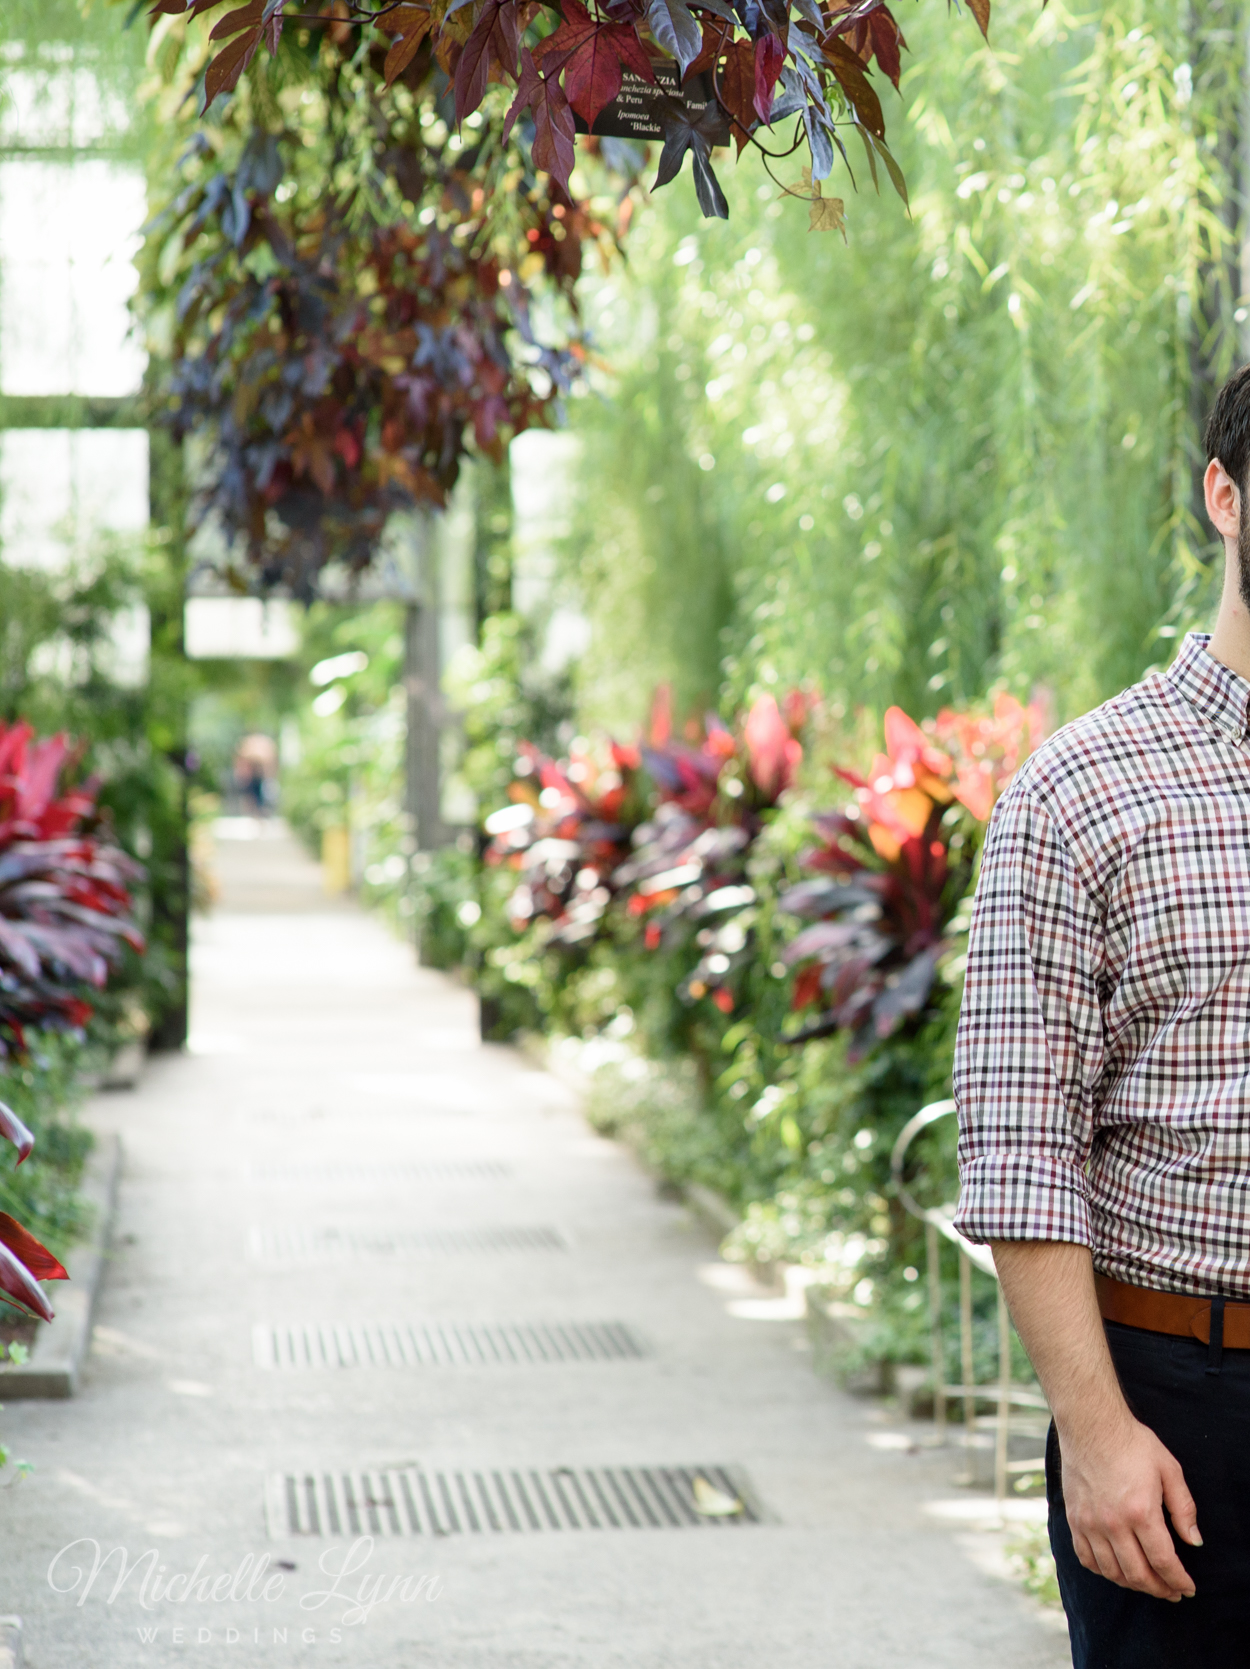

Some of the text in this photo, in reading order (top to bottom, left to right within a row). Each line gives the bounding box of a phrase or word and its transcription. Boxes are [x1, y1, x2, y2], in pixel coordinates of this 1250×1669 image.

[616, 94, 624, 103] &
[625, 94, 643, 104] Peru
[617, 109, 650, 121] Ipomoea
